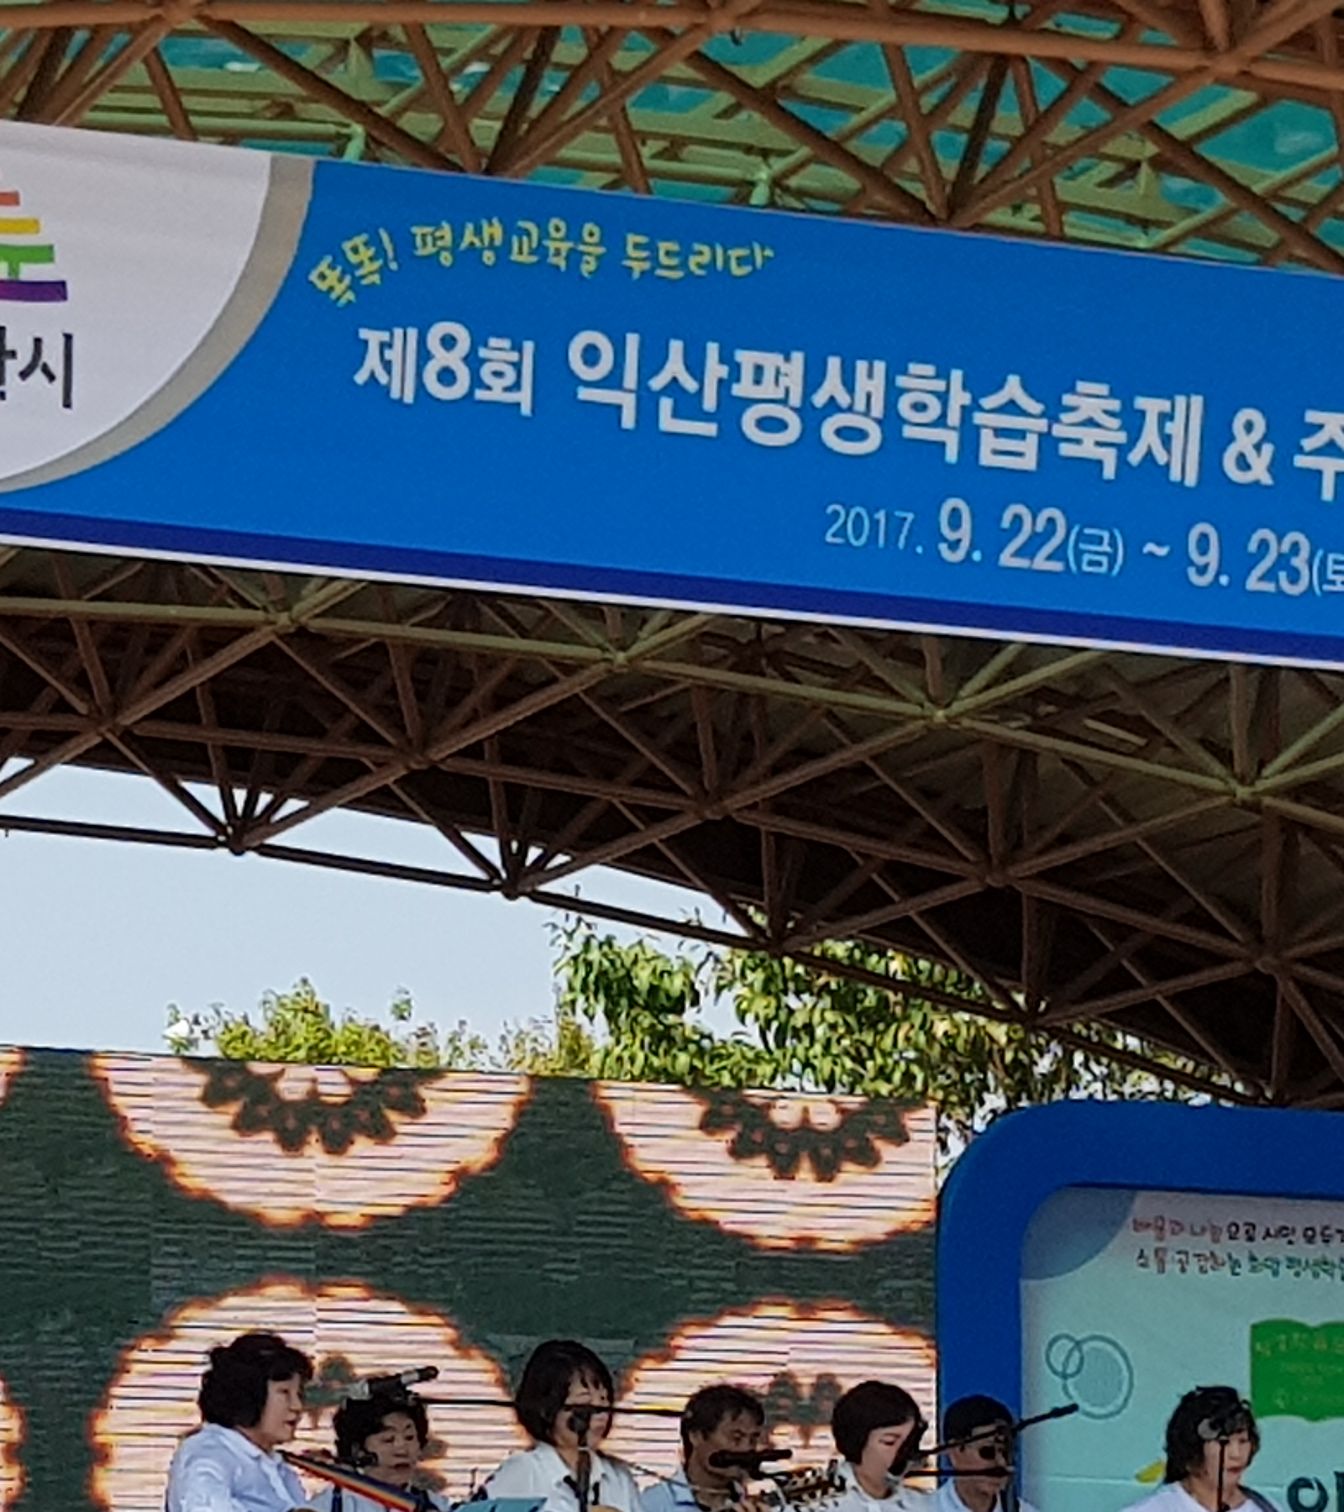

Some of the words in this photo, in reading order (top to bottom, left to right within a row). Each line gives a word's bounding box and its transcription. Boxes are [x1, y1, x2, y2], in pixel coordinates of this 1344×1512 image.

[307, 228, 399, 307] 똑똑!
[410, 217, 607, 279] 평생교육을
[622, 232, 775, 279] 두드리다
[353, 320, 536, 417] 제8회
[567, 330, 1205, 488] 익산평생학습축제
[1222, 407, 1275, 486] &
[824, 504, 924, 554] 2017.
[998, 503, 1124, 577] 22(금)
[1142, 542, 1171, 558] ~
